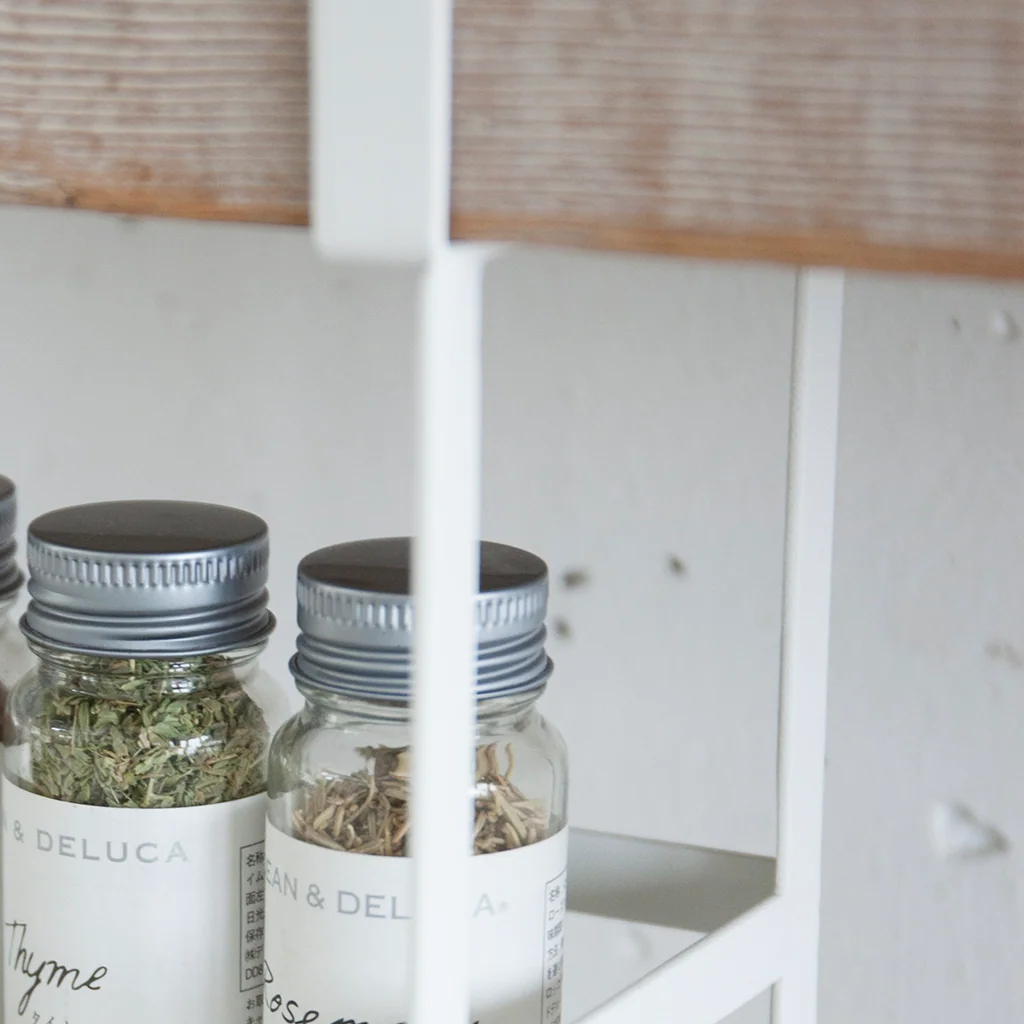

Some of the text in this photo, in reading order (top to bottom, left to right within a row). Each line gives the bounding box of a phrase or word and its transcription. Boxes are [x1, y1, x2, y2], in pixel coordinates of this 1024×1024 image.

[36, 828, 190, 864] DELUCA
[306, 884, 325, 910] &
[5, 919, 108, 1016] Thyme
